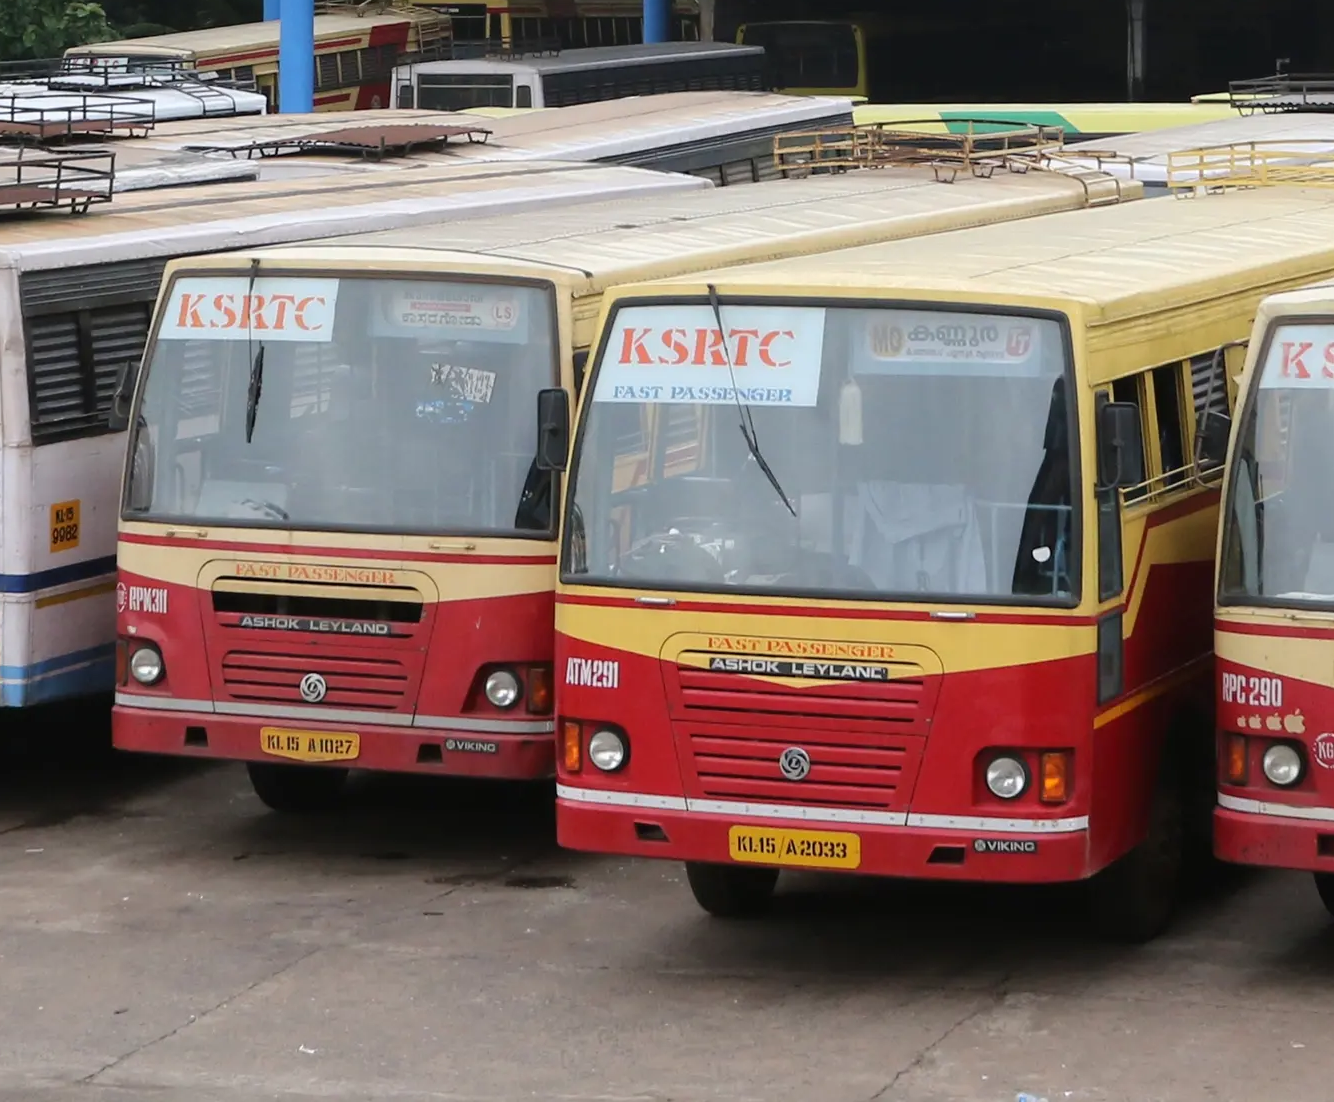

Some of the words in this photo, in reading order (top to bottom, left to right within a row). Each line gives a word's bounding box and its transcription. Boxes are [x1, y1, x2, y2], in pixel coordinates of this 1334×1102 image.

[176, 293, 326, 331] KSRTC
[618, 327, 795, 367] KSRTC
[613, 385, 663, 399] FAST
[670, 386, 793, 402] PASSENGER
[51, 523, 78, 545] 9982
[235, 562, 281, 578] FAST
[287, 565, 397, 584] PASSENGER
[129, 585, 168, 614] RPM311
[240, 615, 299, 630] ASHOK
[309, 619, 388, 635] LEYLAND
[707, 636, 761, 651] FAST
[767, 639, 895, 659] PASSENGER
[565, 657, 618, 689] ATM291
[709, 657, 780, 674] ASHOK
[1222, 671, 1246, 704] RPC
[1248, 677, 1283, 707] 290
[456, 741, 496, 753] VIKING
[986, 840, 1036, 853] VIKING
